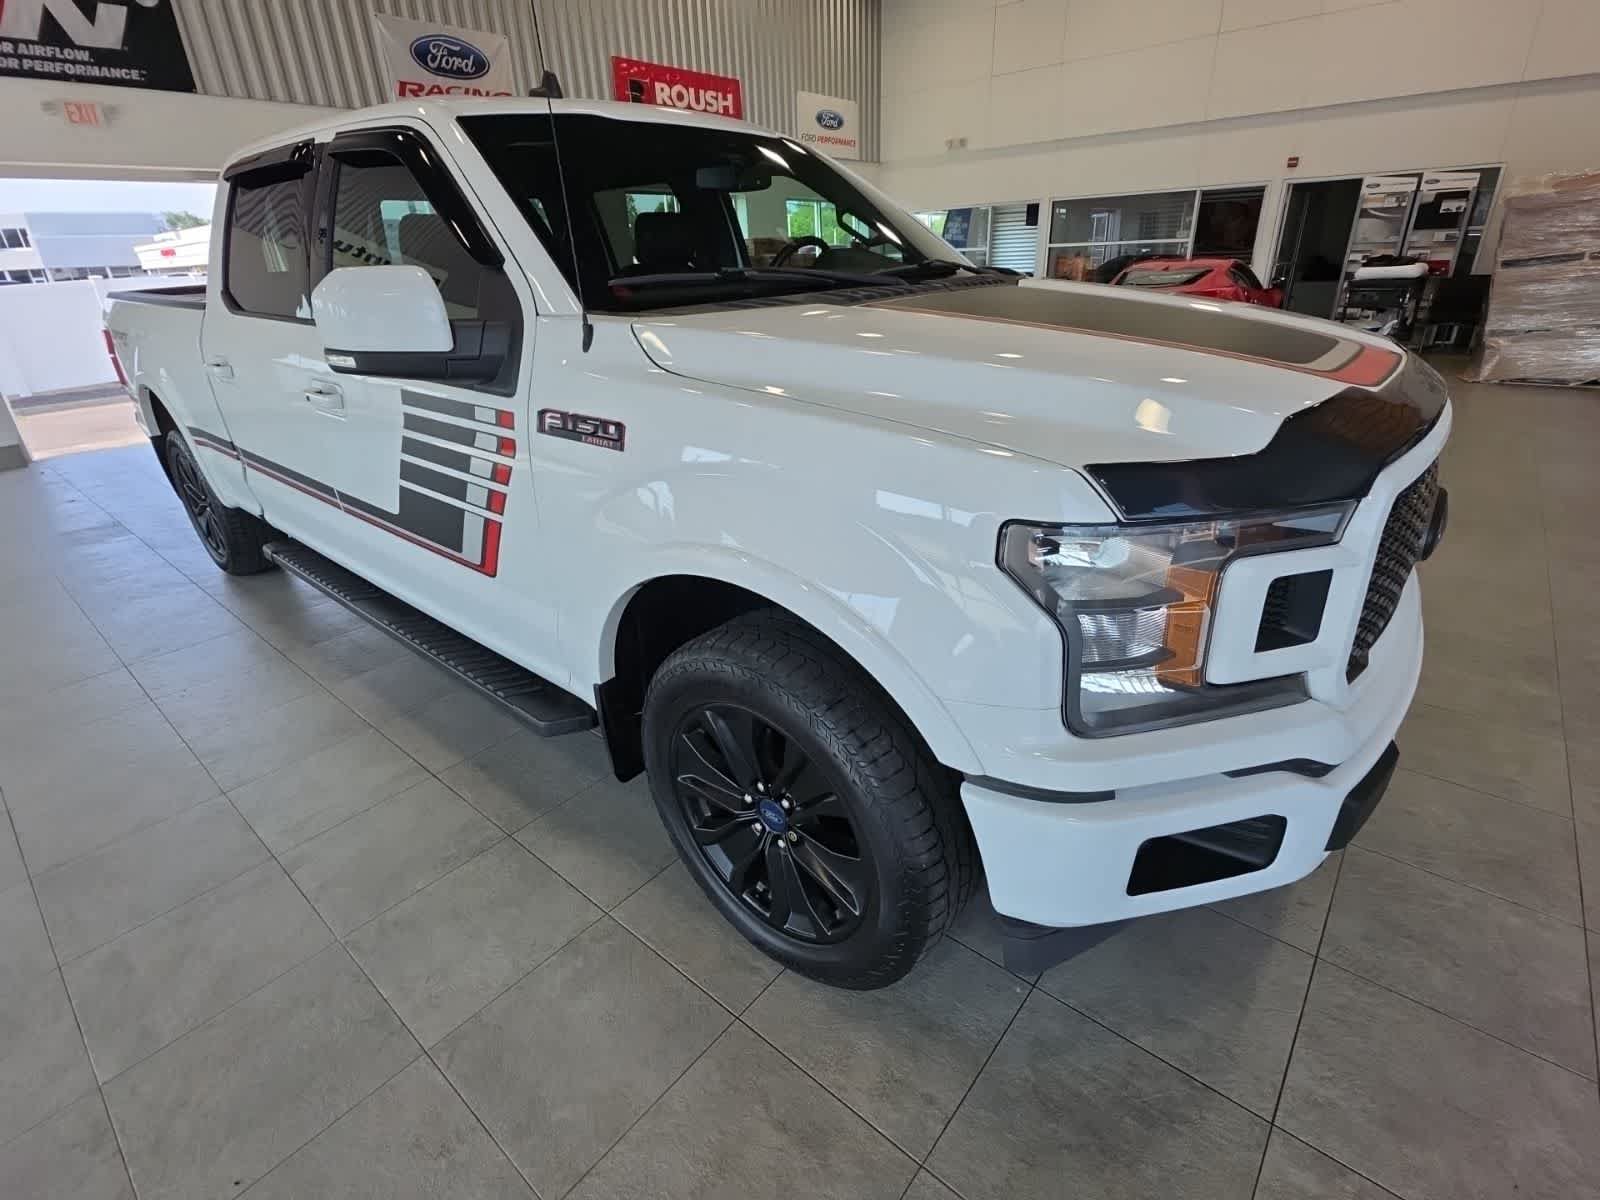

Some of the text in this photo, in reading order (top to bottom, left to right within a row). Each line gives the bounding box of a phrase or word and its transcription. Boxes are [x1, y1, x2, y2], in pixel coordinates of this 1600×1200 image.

[17, 42, 95, 63] AIRFLOW.
[426, 41, 477, 74] Ford
[654, 81, 734, 115] ROUSH
